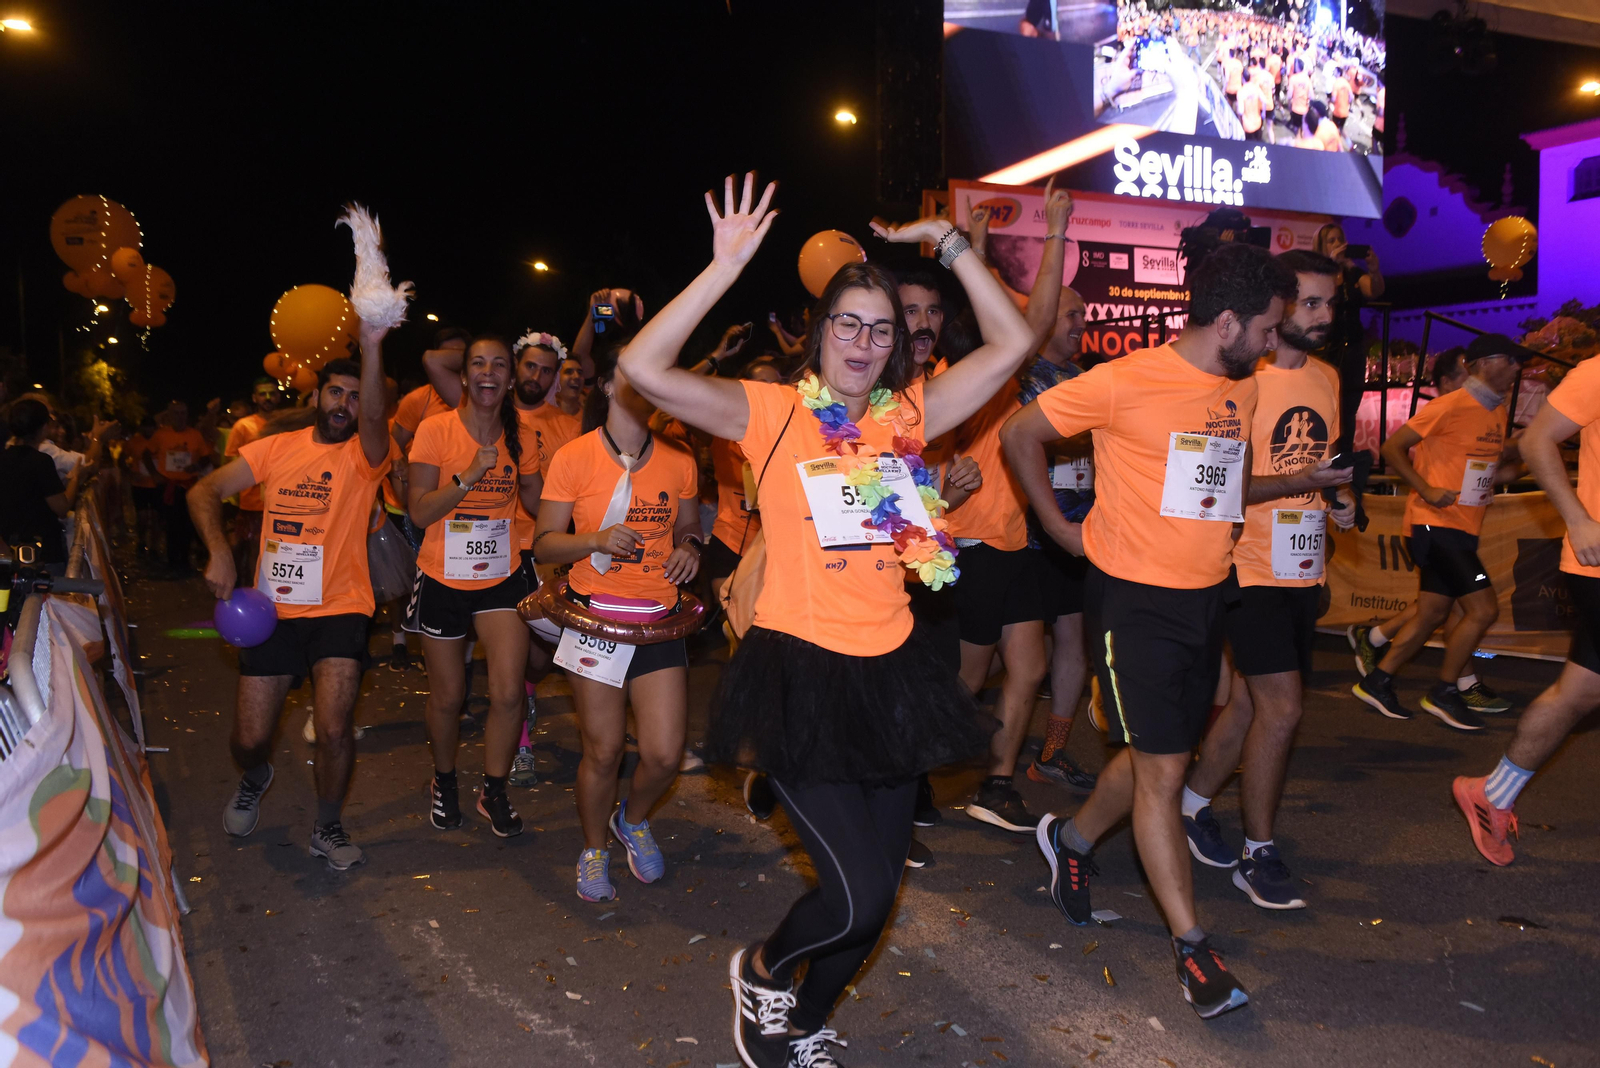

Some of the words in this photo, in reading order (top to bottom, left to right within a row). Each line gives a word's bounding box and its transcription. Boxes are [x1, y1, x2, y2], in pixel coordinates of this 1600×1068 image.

[1067, 215, 1111, 229] ruzcampo
[1109, 286, 1120, 297] 30
[1121, 287, 1133, 298] de
[1205, 419, 1241, 429] NOCTURNA
[1273, 464, 1283, 472] LA
[1194, 464, 1227, 487] 3965
[278, 487, 309, 498] SEVILLA
[297, 483, 332, 492] NOCTURNA
[466, 540, 497, 555] 5852
[1289, 533, 1323, 550] 10157
[272, 562, 303, 580] 5574
[1350, 592, 1408, 612] Instituto
